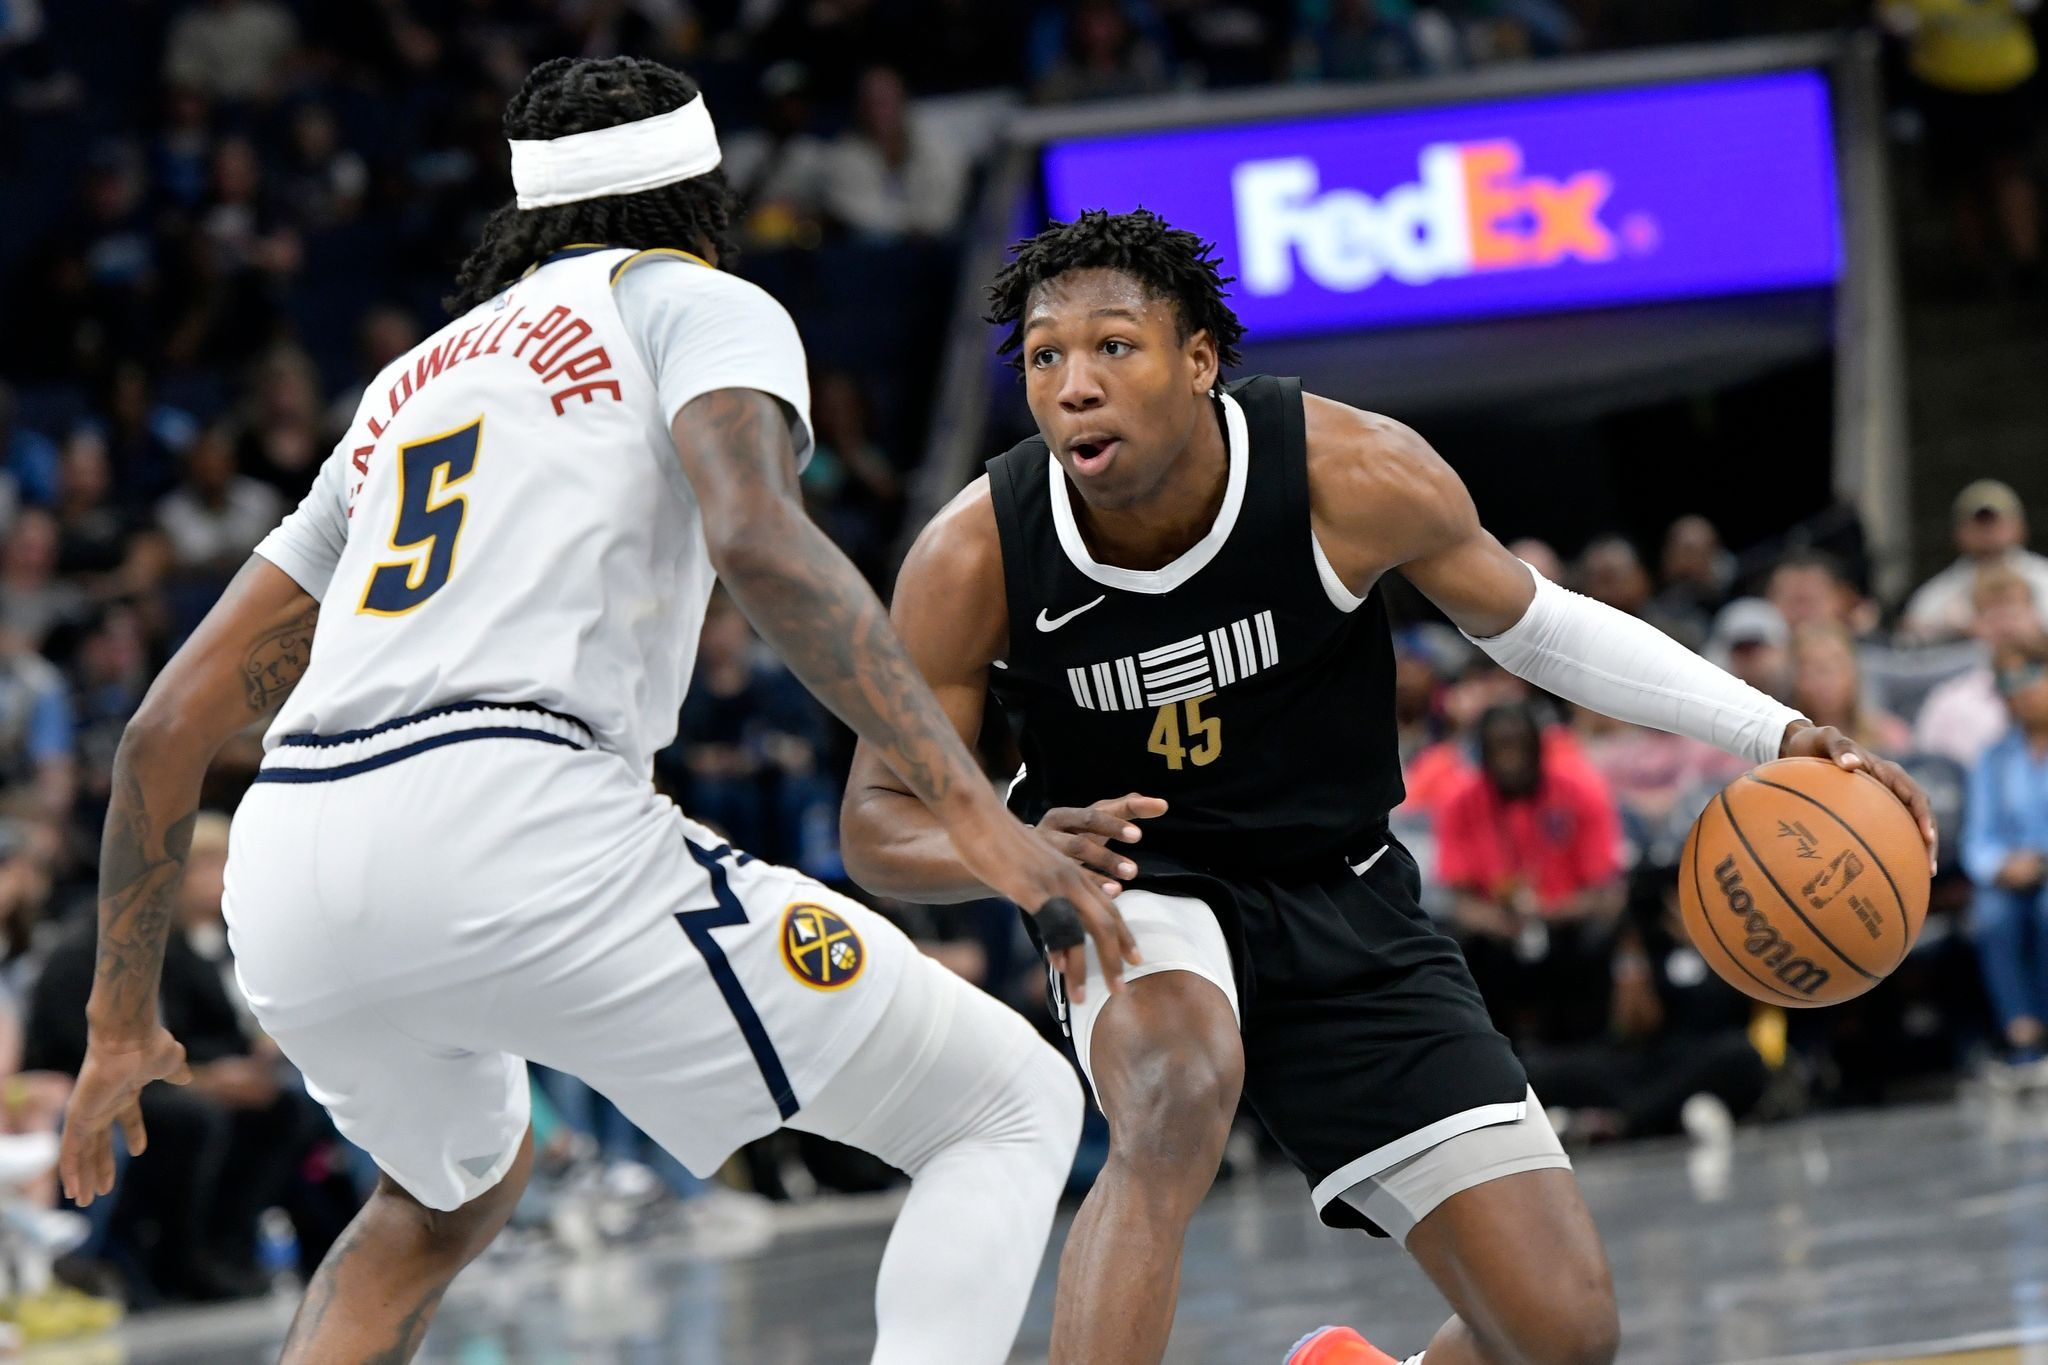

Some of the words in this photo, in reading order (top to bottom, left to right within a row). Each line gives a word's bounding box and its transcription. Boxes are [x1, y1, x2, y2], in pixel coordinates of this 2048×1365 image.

[1232, 140, 1617, 294] FedEx
[355, 413, 485, 617] 5
[1147, 692, 1222, 769] 45
[1714, 854, 1831, 994] Wilson
